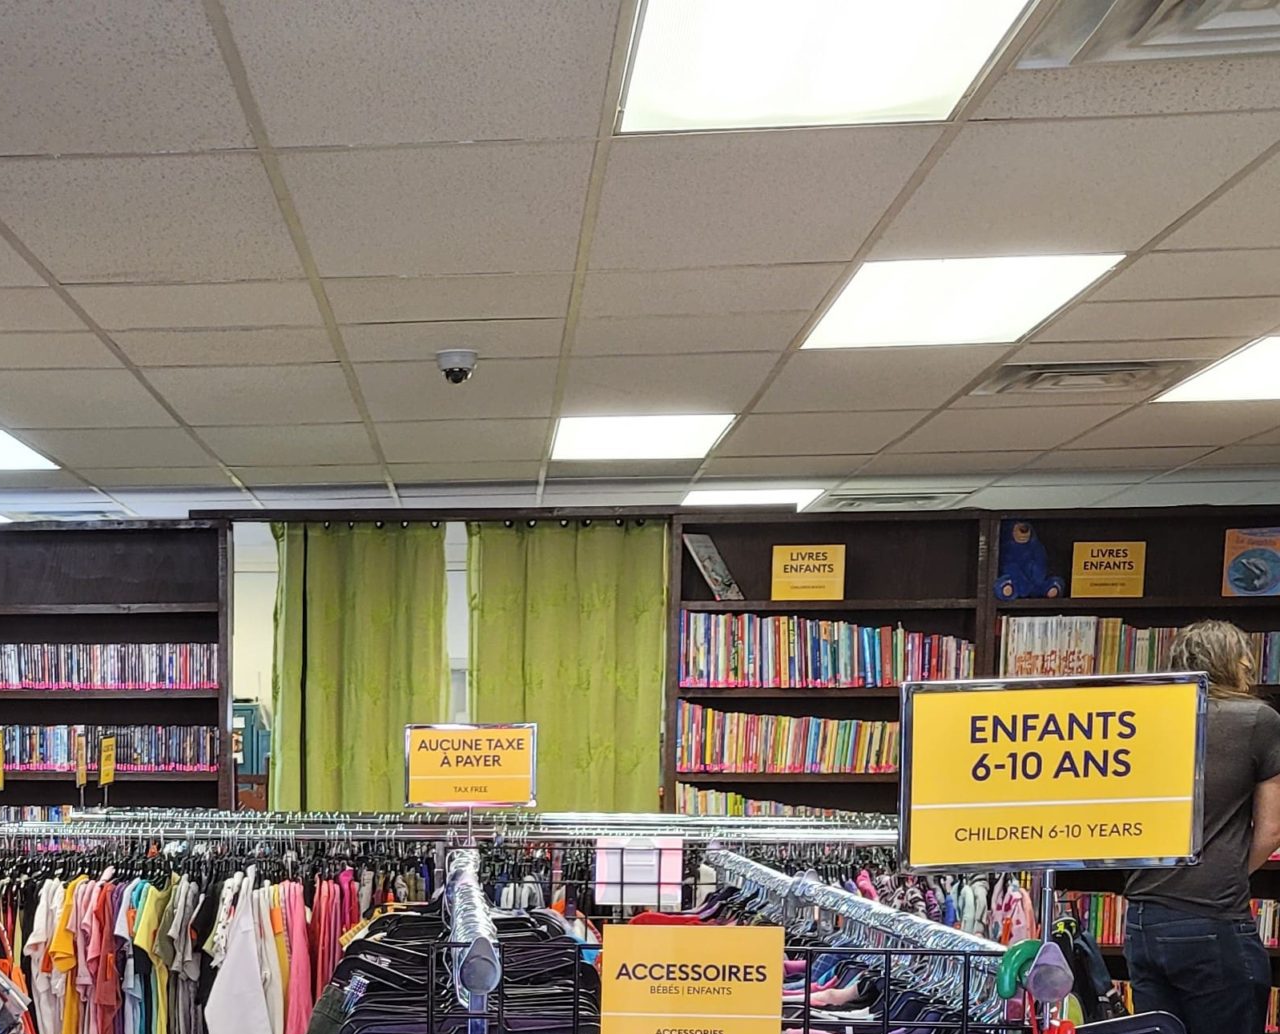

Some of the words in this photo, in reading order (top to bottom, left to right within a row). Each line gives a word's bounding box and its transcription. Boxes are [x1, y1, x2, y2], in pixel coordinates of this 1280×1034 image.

[790, 552, 828, 561] LIVRES
[1090, 549, 1128, 558] LIVRES
[783, 564, 834, 573] ENFANTS
[1083, 561, 1134, 571] ENFANTS
[970, 710, 1136, 744] ENFANTS
[418, 739, 482, 751] AUCUNE
[486, 738, 525, 750] TAXE
[440, 752, 451, 767] À
[456, 755, 502, 767] PAYER
[971, 751, 1042, 782] 6-10
[1053, 749, 1131, 779] ANS
[954, 826, 1043, 842] CHILDREN
[1048, 823, 1082, 839] 6-10
[1087, 822, 1143, 838] YEARS
[615, 963, 767, 983] ACCESSOIRES
[650, 985, 680, 995] BÉBÉS
[687, 986, 732, 996] ENFANTS
